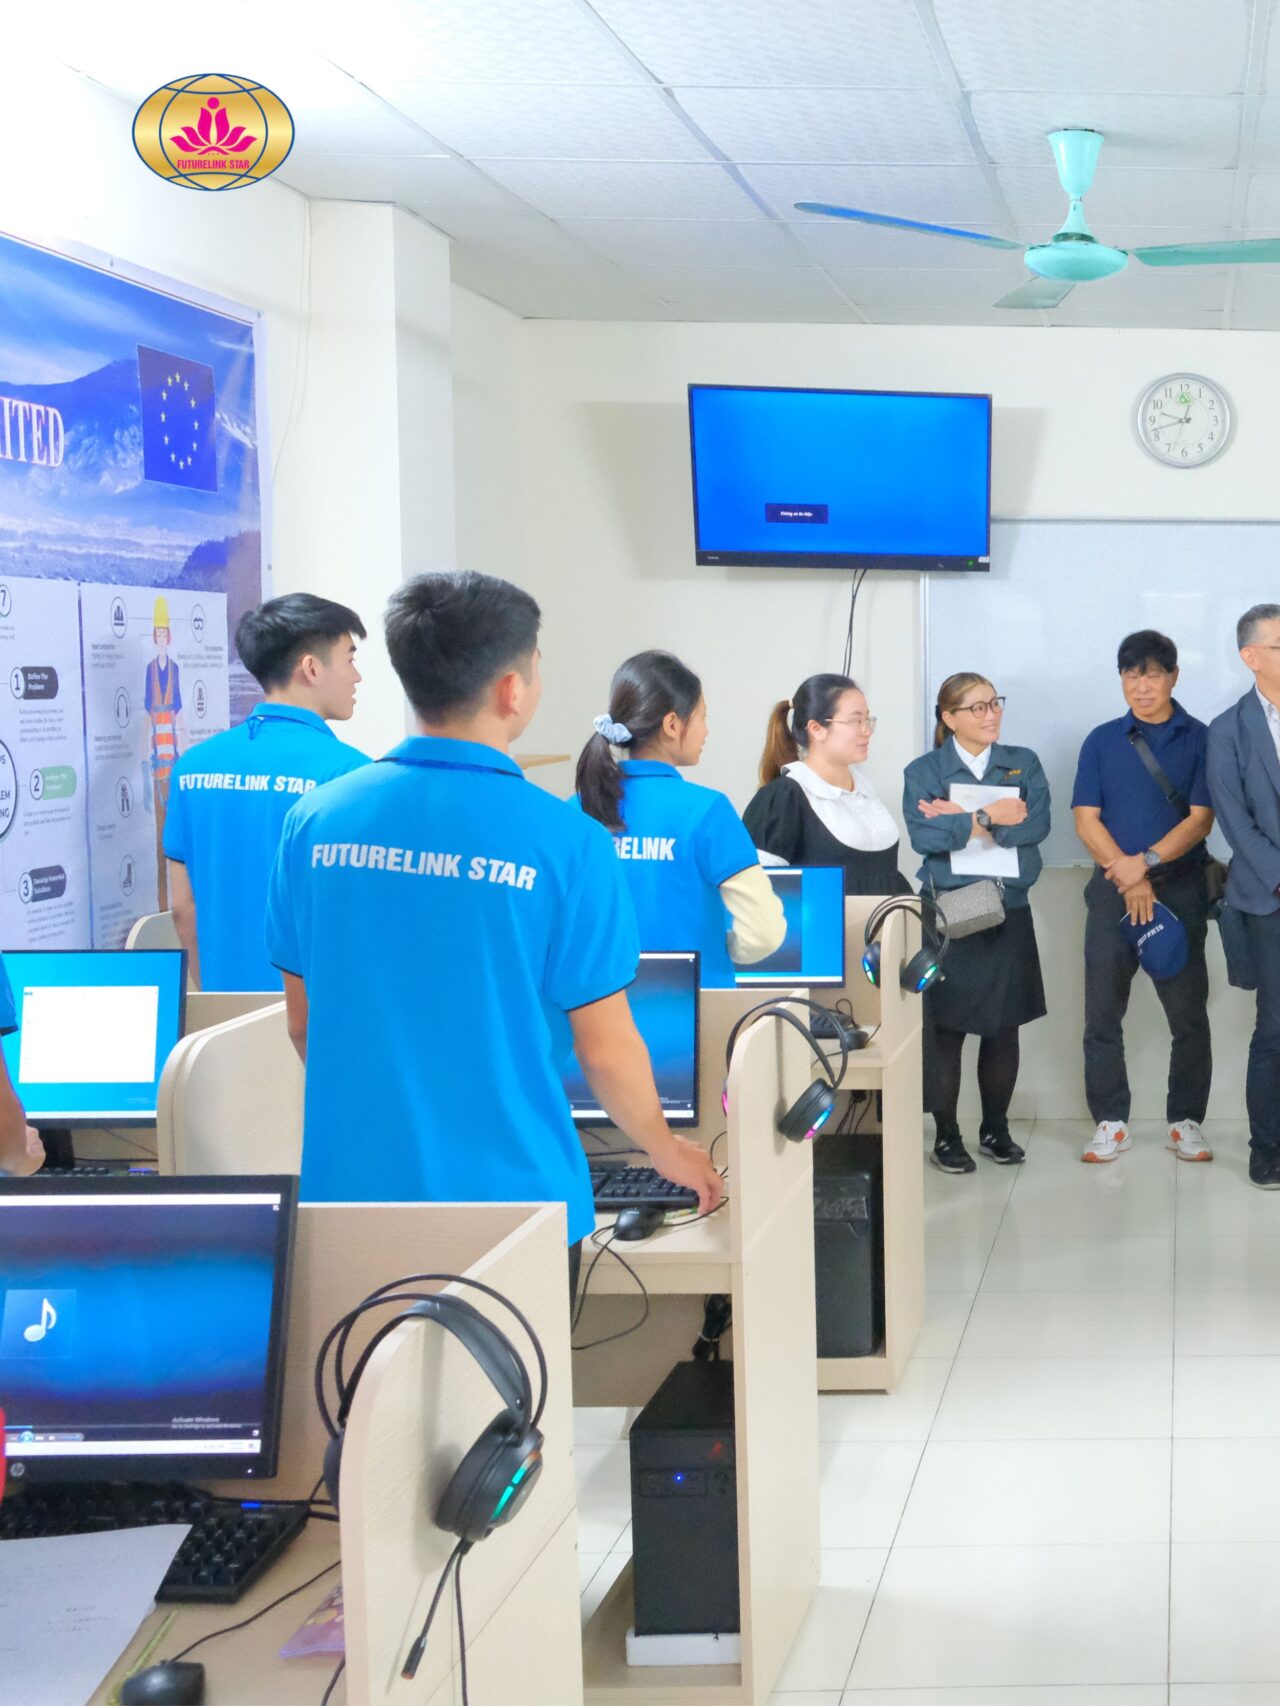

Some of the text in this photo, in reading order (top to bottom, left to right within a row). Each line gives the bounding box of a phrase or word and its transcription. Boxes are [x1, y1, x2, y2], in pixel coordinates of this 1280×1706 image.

[1165, 387, 1172, 398] 11
[1180, 383, 1190, 392] 12
[1153, 399, 1163, 410] 10
[1208, 399, 1215, 410] 2
[1149, 416, 1156, 426] 9
[1212, 416, 1218, 426] 3
[0, 396, 65, 467] ITED
[1153, 431, 1160, 441] 8
[1207, 431, 1214, 441] 4
[1165, 442, 1171, 453] 7
[1181, 447, 1188, 457] 6
[1196, 442, 1203, 454] 5
[14, 674, 20, 690] 1
[34, 775, 40, 792] 2
[179, 773, 271, 791] FUTURELINK
[311, 843, 537, 891] FUTURELINK STAR
[22, 880, 29, 897] 3
